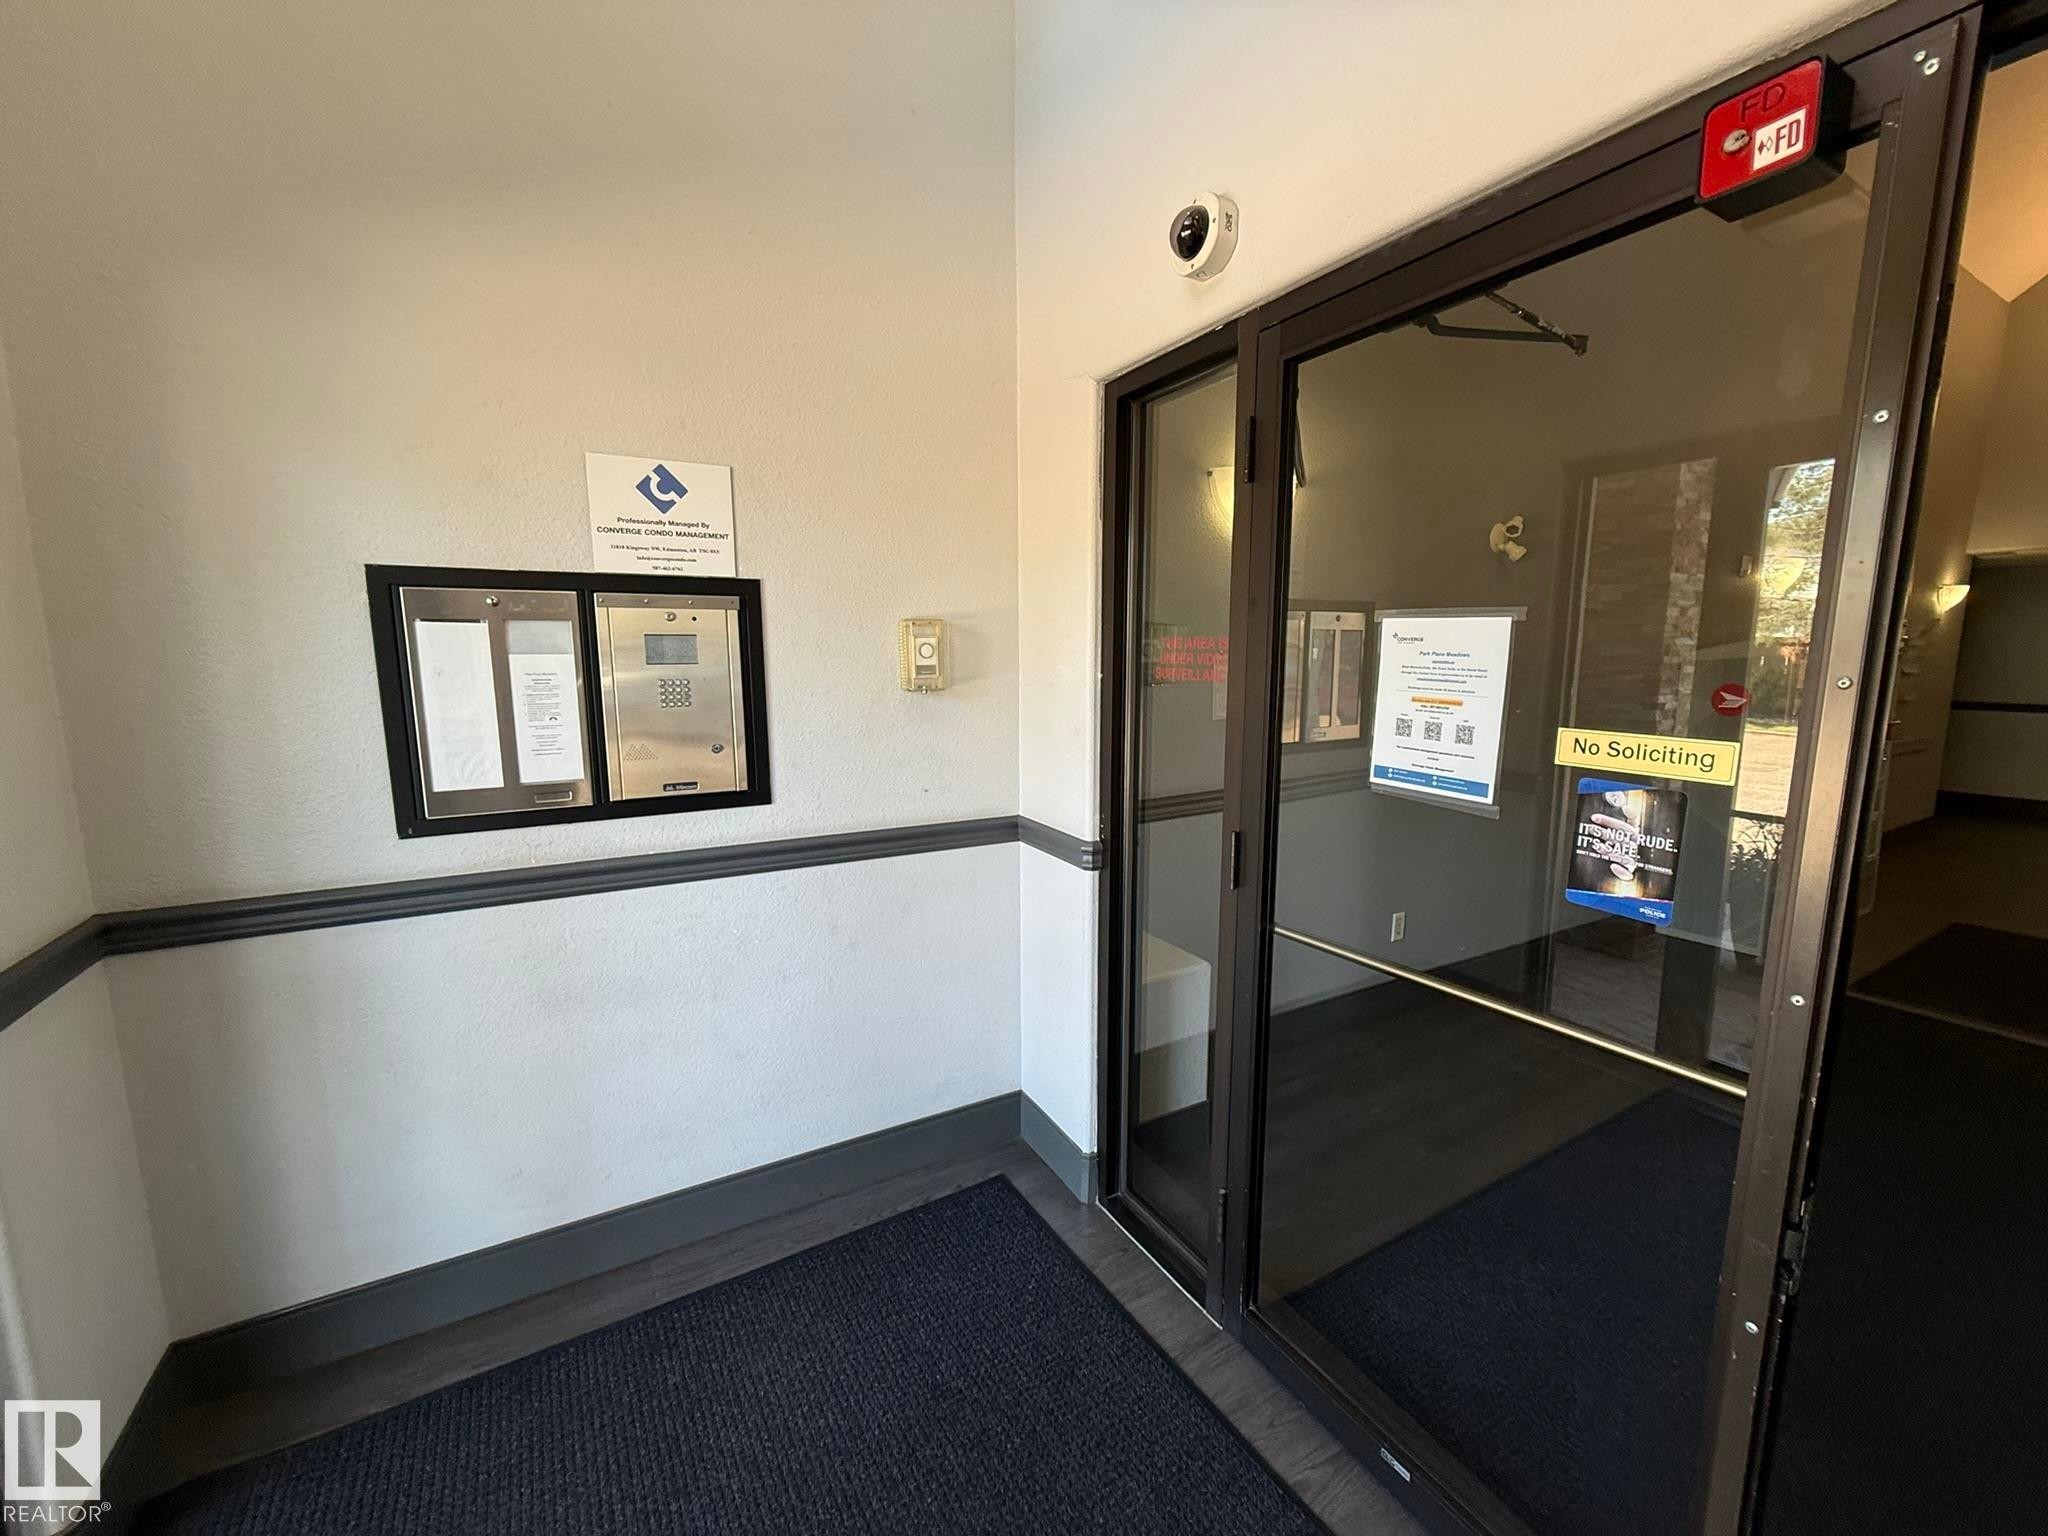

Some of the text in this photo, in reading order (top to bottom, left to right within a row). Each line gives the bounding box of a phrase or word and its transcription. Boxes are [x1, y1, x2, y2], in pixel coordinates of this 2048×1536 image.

[1740, 82, 1787, 122] FD
[1774, 118, 1801, 155] FD
[597, 527, 730, 540] CONVERGE CONDO MANAGEMENT
[617, 517, 667, 527] Professionally
[668, 520, 700, 529] Managed
[1572, 737, 1716, 773] No Soliciting
[1577, 836, 1642, 859] IT'S SAFE.
[1578, 822, 1679, 853] IT'S NOT RUDE.
[1639, 908, 1667, 919] POLICE
